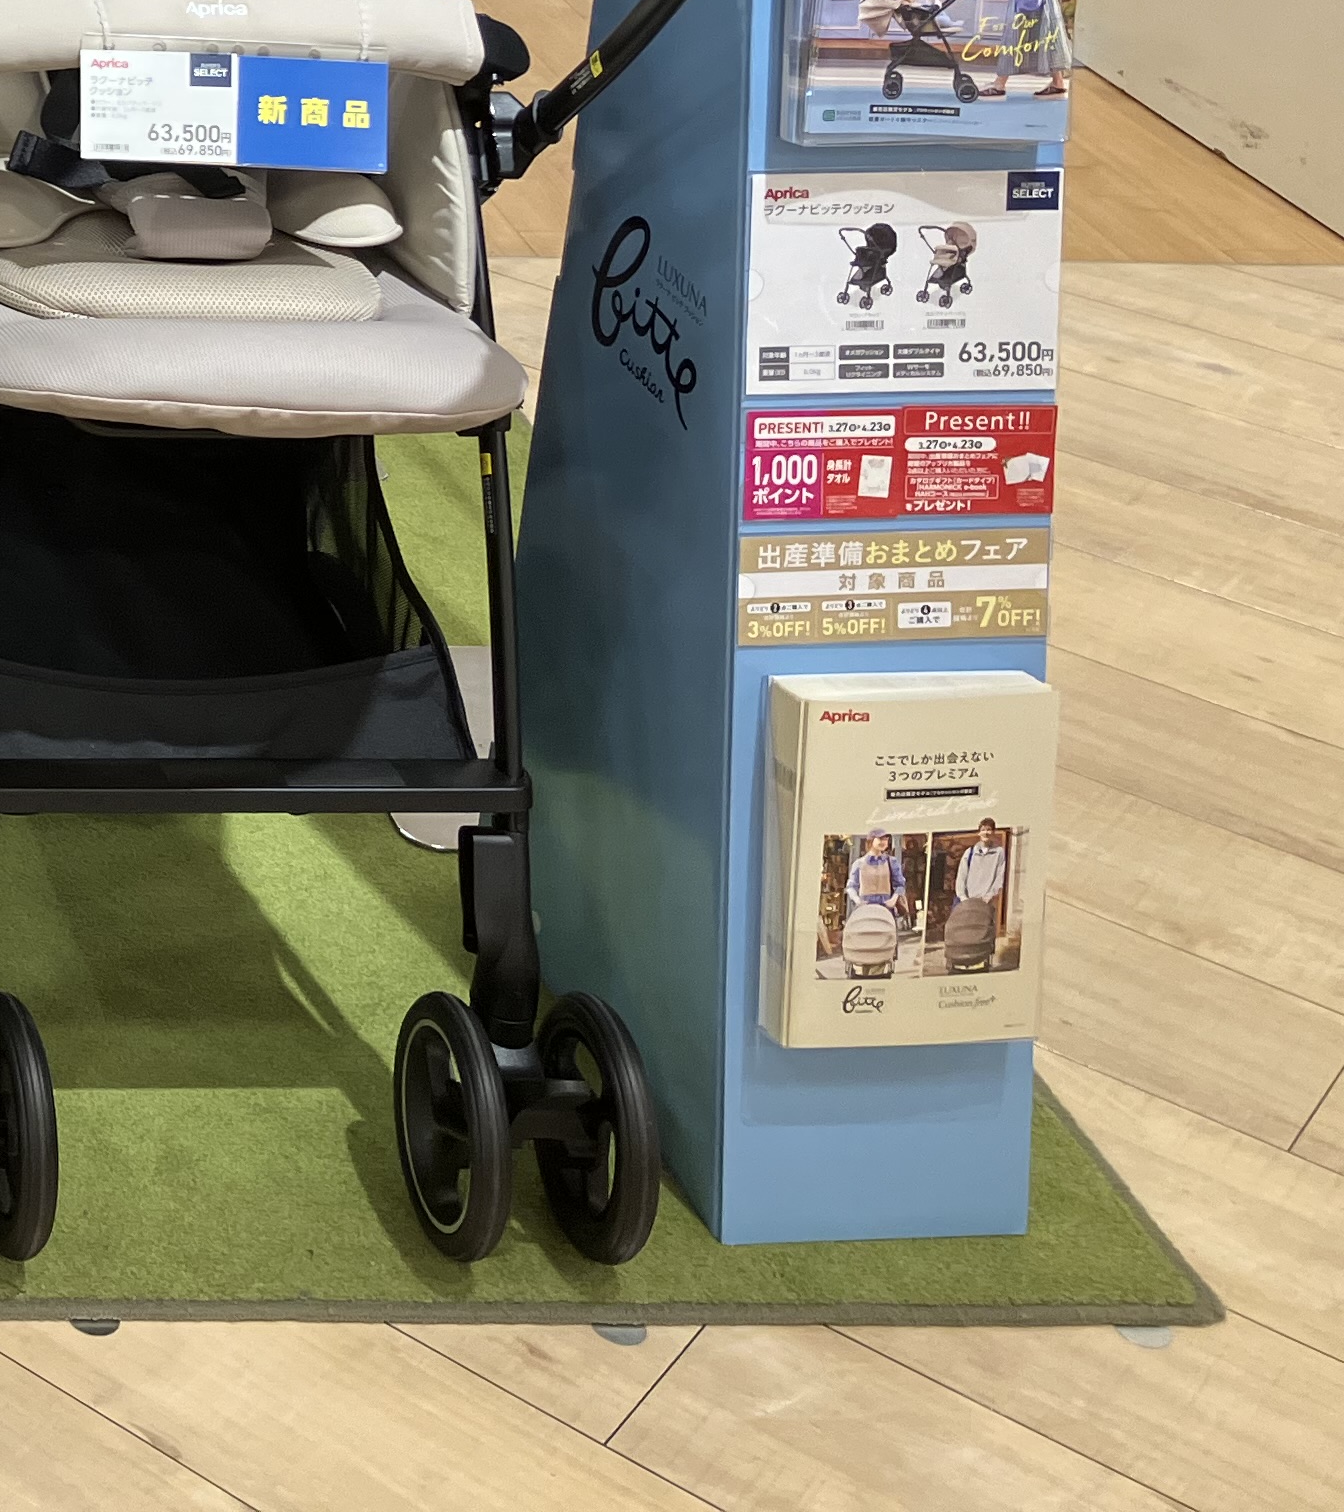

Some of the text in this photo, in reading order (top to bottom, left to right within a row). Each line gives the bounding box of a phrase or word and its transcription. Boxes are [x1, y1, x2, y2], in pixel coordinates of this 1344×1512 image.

[185, 0, 249, 18] Aprica
[90, 58, 129, 70] Aprica
[193, 68, 228, 78] SELECT
[257, 95, 371, 129] 新商品
[147, 124, 232, 144] 63,500円
[764, 187, 810, 202] Aprica
[1012, 188, 1054, 199] SELECT
[763, 203, 895, 216] ラクーナビッテクッション
[958, 341, 1054, 363] 63,500円
[759, 421, 824, 434] PRESENT!
[925, 411, 1030, 431] Present!!
[752, 455, 818, 486] 1,000
[826, 459, 852, 471] 身長計
[826, 473, 851, 484] タオル
[752, 488, 814, 505] ポイント
[758, 538, 1028, 570] 出産準備おまとめフェア
[839, 571, 945, 592] 対象商品
[822, 617, 886, 636] 5%OFF!
[909, 616, 941, 625] ご購入で
[997, 609, 1041, 627] OFF!
[748, 621, 811, 638] 3%OFF!
[819, 709, 870, 724] Aprica
[874, 750, 995, 767] ここでしか出会えない
[888, 769, 979, 782] 3つのプレミアム
